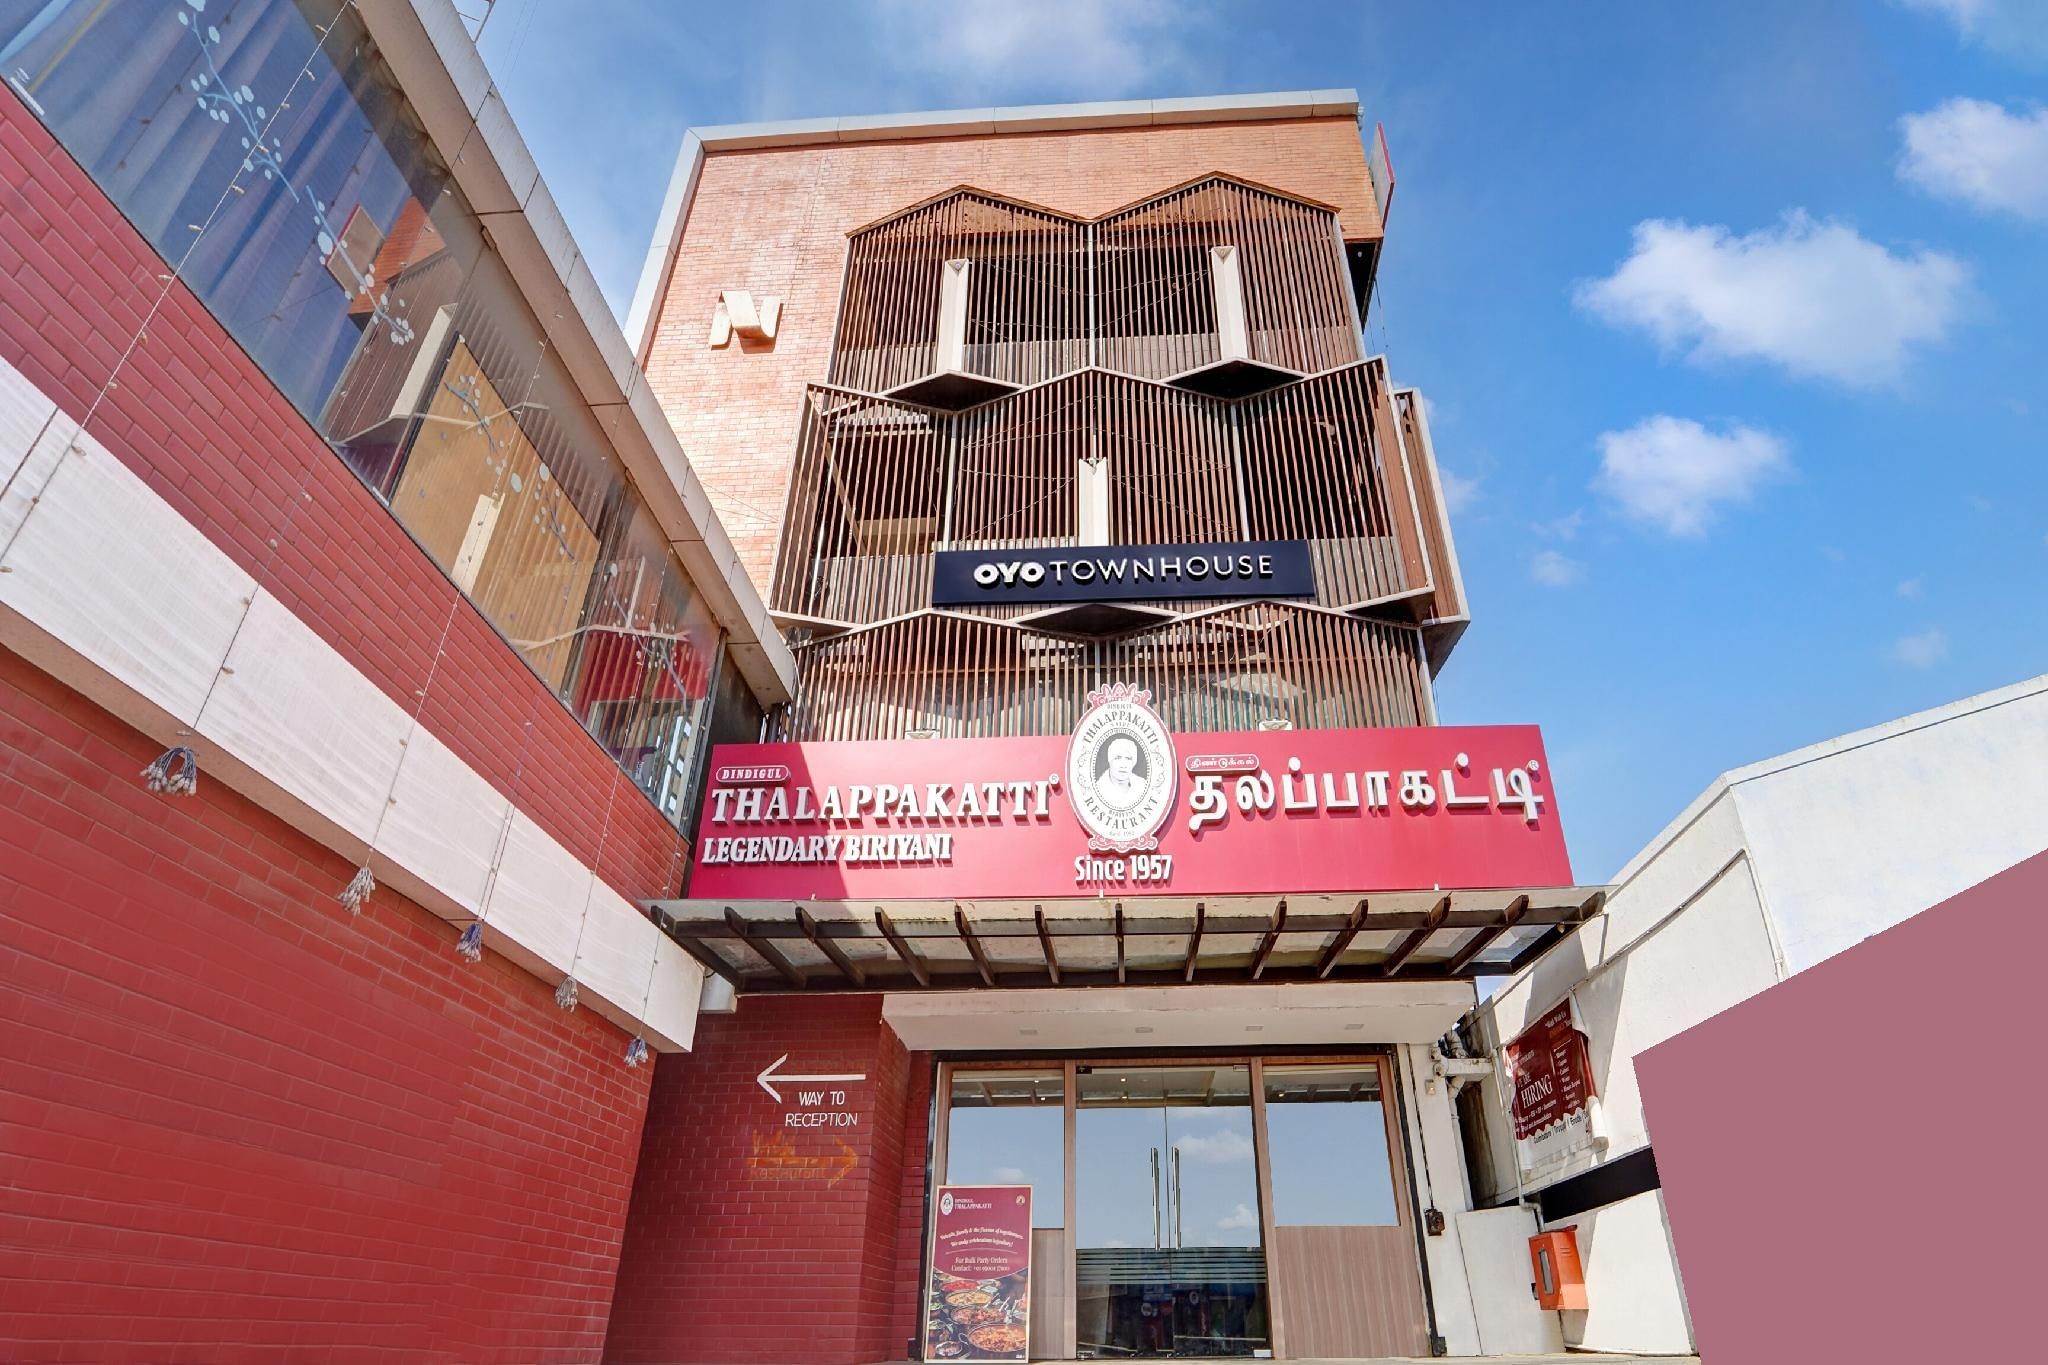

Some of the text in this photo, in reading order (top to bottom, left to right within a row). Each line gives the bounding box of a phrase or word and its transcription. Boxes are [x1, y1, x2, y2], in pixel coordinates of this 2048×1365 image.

[973, 554, 1273, 584] OYO TOWNHOUSE
[1083, 711, 1159, 744] THALAPPAKATTI
[721, 768, 782, 780] DINDIGUL
[1188, 752, 1545, 831] தலப்பாகட்டி
[1084, 796, 1158, 829] RESTAURANT
[701, 833, 952, 864] LEGENDARY BIRIYANI
[1074, 854, 1173, 881] Since 1957
[799, 1090, 845, 1107] WAY TO
[1521, 1074, 1552, 1108] HIRING
[785, 1112, 858, 1128] RECEPTION
